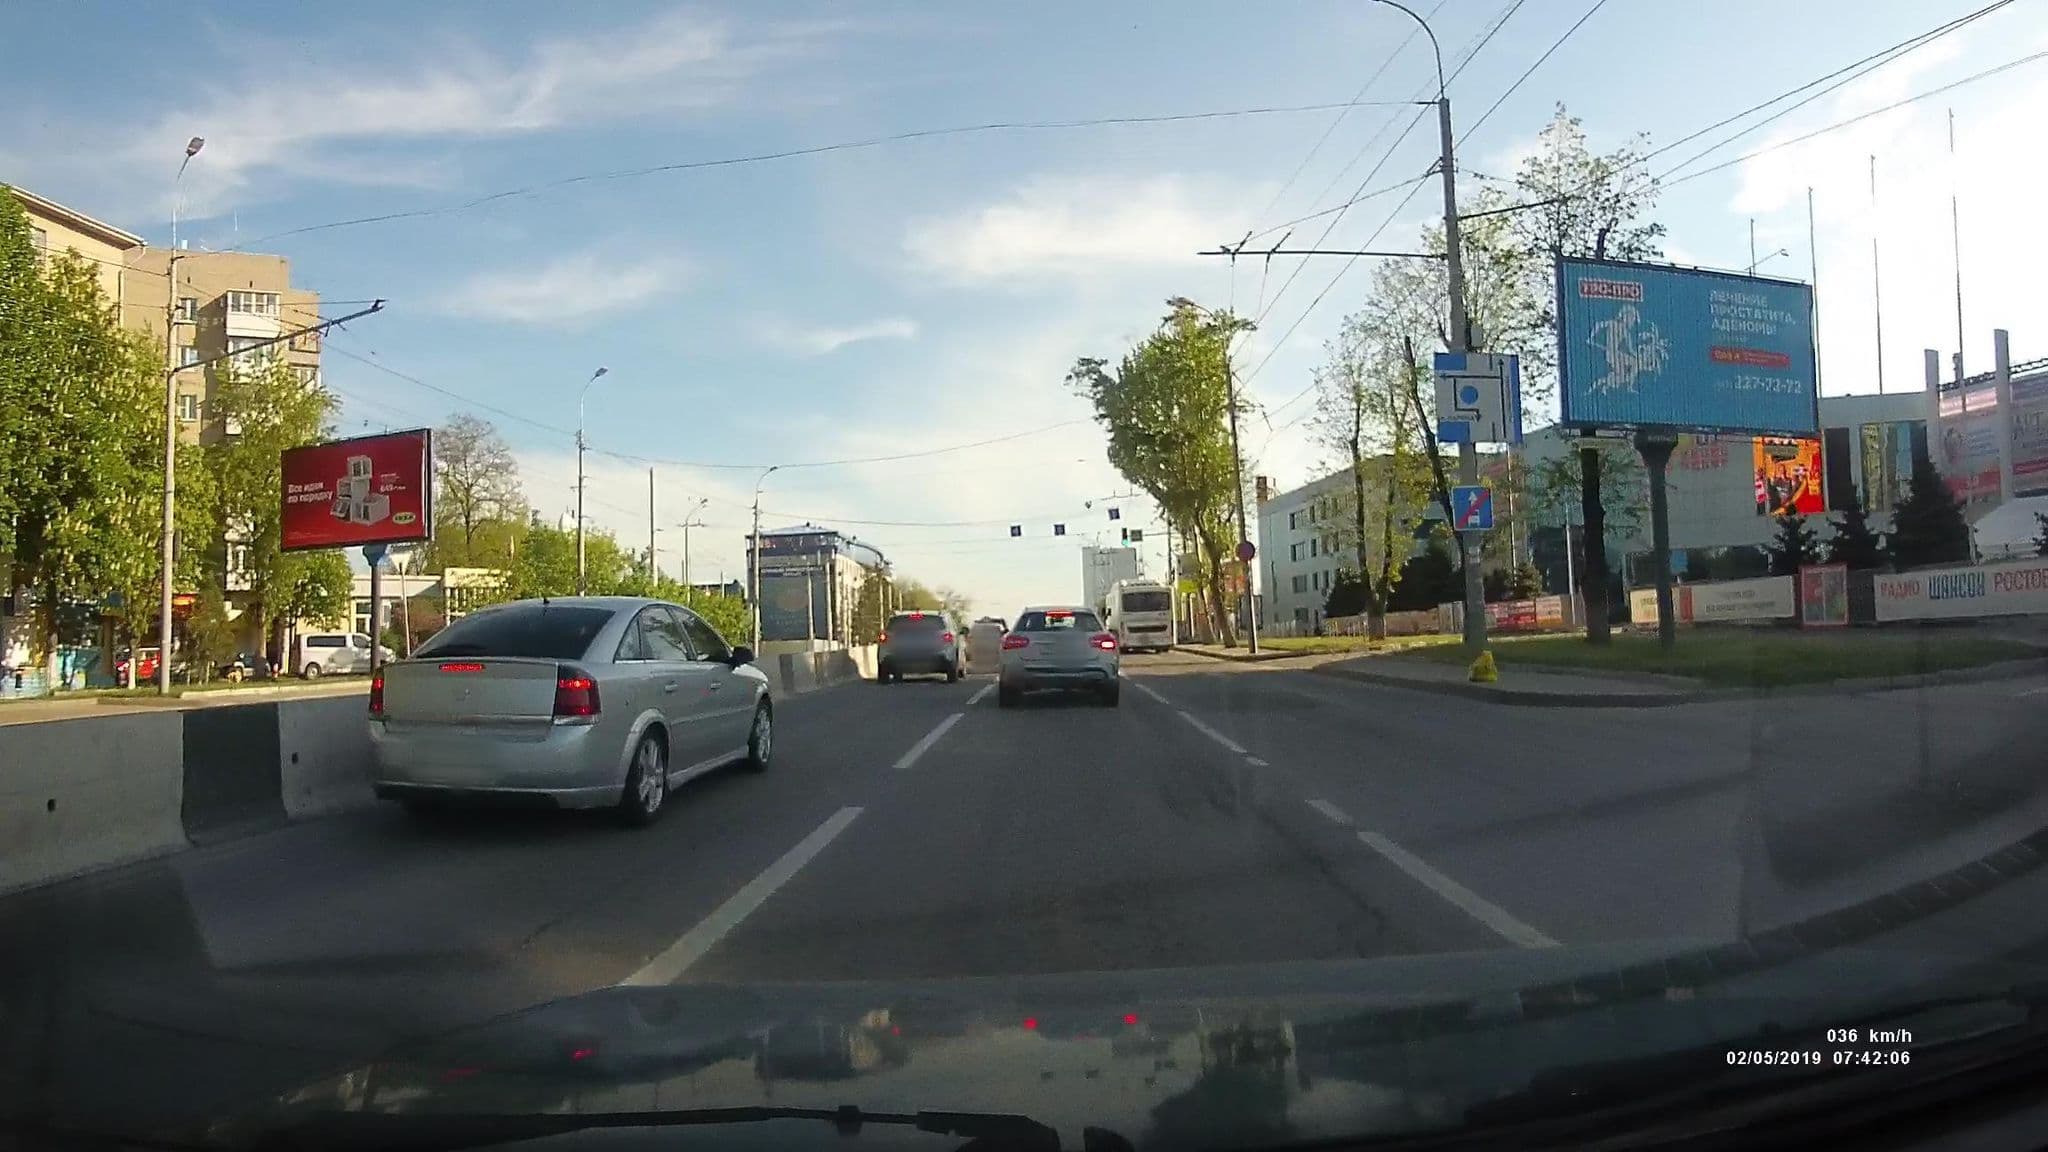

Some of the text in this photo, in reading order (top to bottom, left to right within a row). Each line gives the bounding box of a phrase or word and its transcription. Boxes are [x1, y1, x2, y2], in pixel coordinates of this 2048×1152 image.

[288, 484, 303, 494] Все
[1879, 580, 1920, 599] РАДИО
[1928, 571, 1985, 600] ШАНСОН
